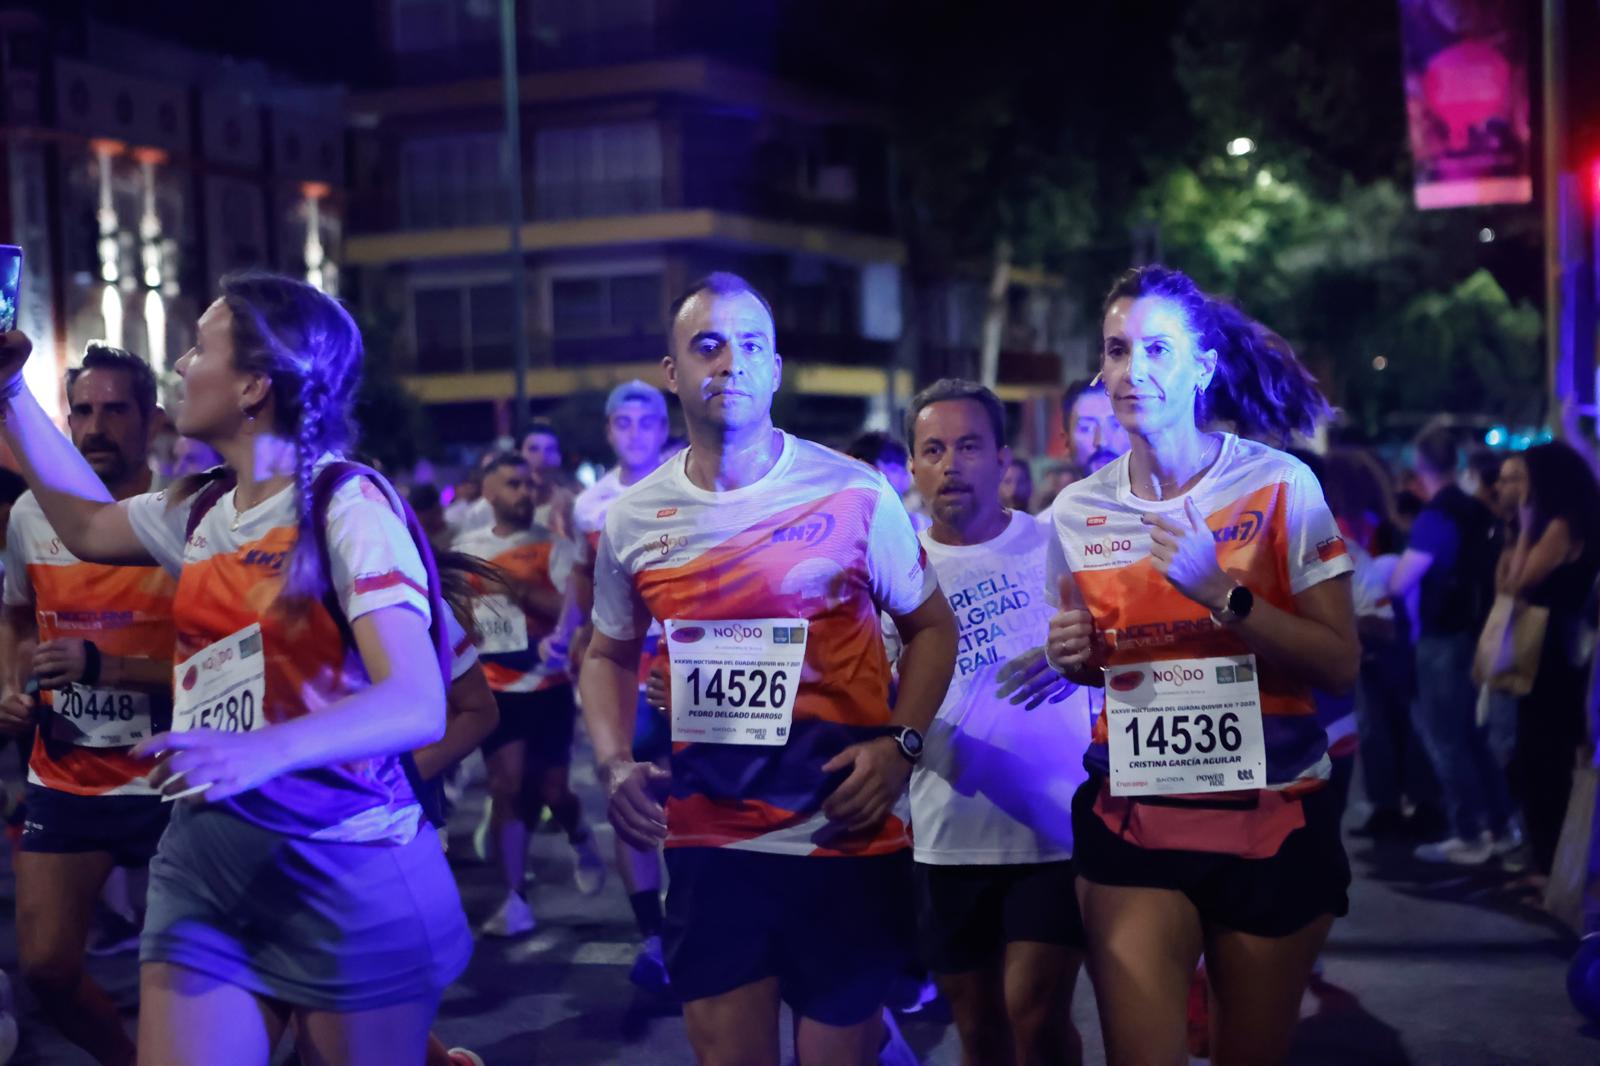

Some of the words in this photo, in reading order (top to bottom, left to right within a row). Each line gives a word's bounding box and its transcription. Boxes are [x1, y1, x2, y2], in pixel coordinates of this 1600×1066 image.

[687, 667, 787, 709] 14526
[60, 689, 136, 721] 20448
[688, 710, 714, 718] PEDRO
[715, 711, 750, 719] DELGADO
[750, 712, 783, 720] BARROSO
[1125, 712, 1242, 756] 14536
[1129, 760, 1167, 768] CRISTINA
[1169, 758, 1201, 766] GARCÍA
[1203, 756, 1241, 764] AGUILAR
